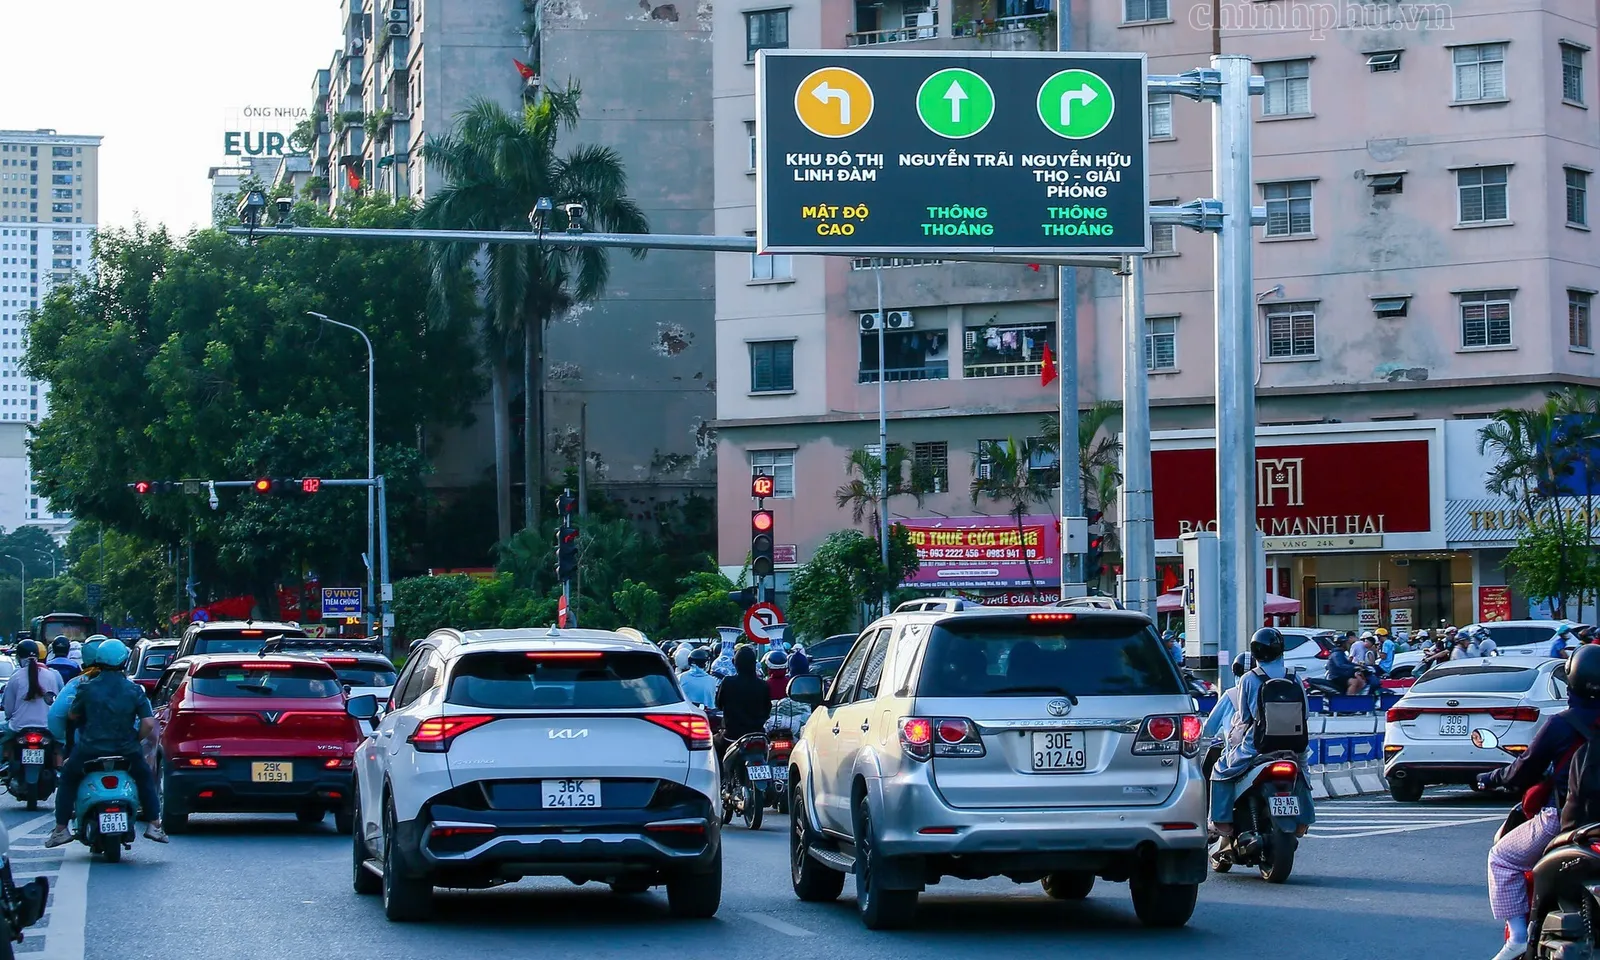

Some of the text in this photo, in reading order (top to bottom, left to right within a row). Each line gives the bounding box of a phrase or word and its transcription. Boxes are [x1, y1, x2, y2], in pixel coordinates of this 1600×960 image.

[243, 103, 308, 120] ỐNG NHỰA
[786, 149, 884, 169] KHU ĐÔ THỊ
[898, 148, 1014, 167] NGUYỄN TRÃI
[1021, 149, 1132, 167] NGUYỄN HỮU
[793, 165, 877, 182] LINH ĐÀM
[1032, 169, 1070, 185] THỌ
[1085, 166, 1121, 183] GIẢI
[1046, 182, 1108, 198] PHÓNG
[802, 203, 869, 222] MẬT ĐỘ
[926, 203, 988, 219] THÔNG
[1046, 203, 1108, 219] THÔNG
[816, 222, 855, 236] CAO
[920, 219, 994, 236] THOÁNG
[1041, 219, 1114, 236] THOÁNG
[303, 478, 319, 492] 102
[755, 479, 770, 493] 102
[929, 529, 964, 546] THUÊ
[999, 529, 1038, 546] HÀNG
[1316, 540, 1334, 548] 24K
[929, 548, 944, 558] 093
[945, 548, 963, 558] 2222
[964, 548, 979, 558] 456
[333, 590, 359, 598] VNVC
[1446, 715, 1462, 725] 30G
[1045, 732, 1073, 749] 30E
[263, 762, 281, 772] 29K
[1035, 750, 1084, 768] 312.49
[257, 772, 288, 781] 119.91
[557, 780, 585, 793] 36K
[547, 793, 597, 807] 241.29
[103, 813, 123, 822] 29-F1
[1272, 805, 1299, 815] 762.76
[101, 822, 127, 832] 698.15
